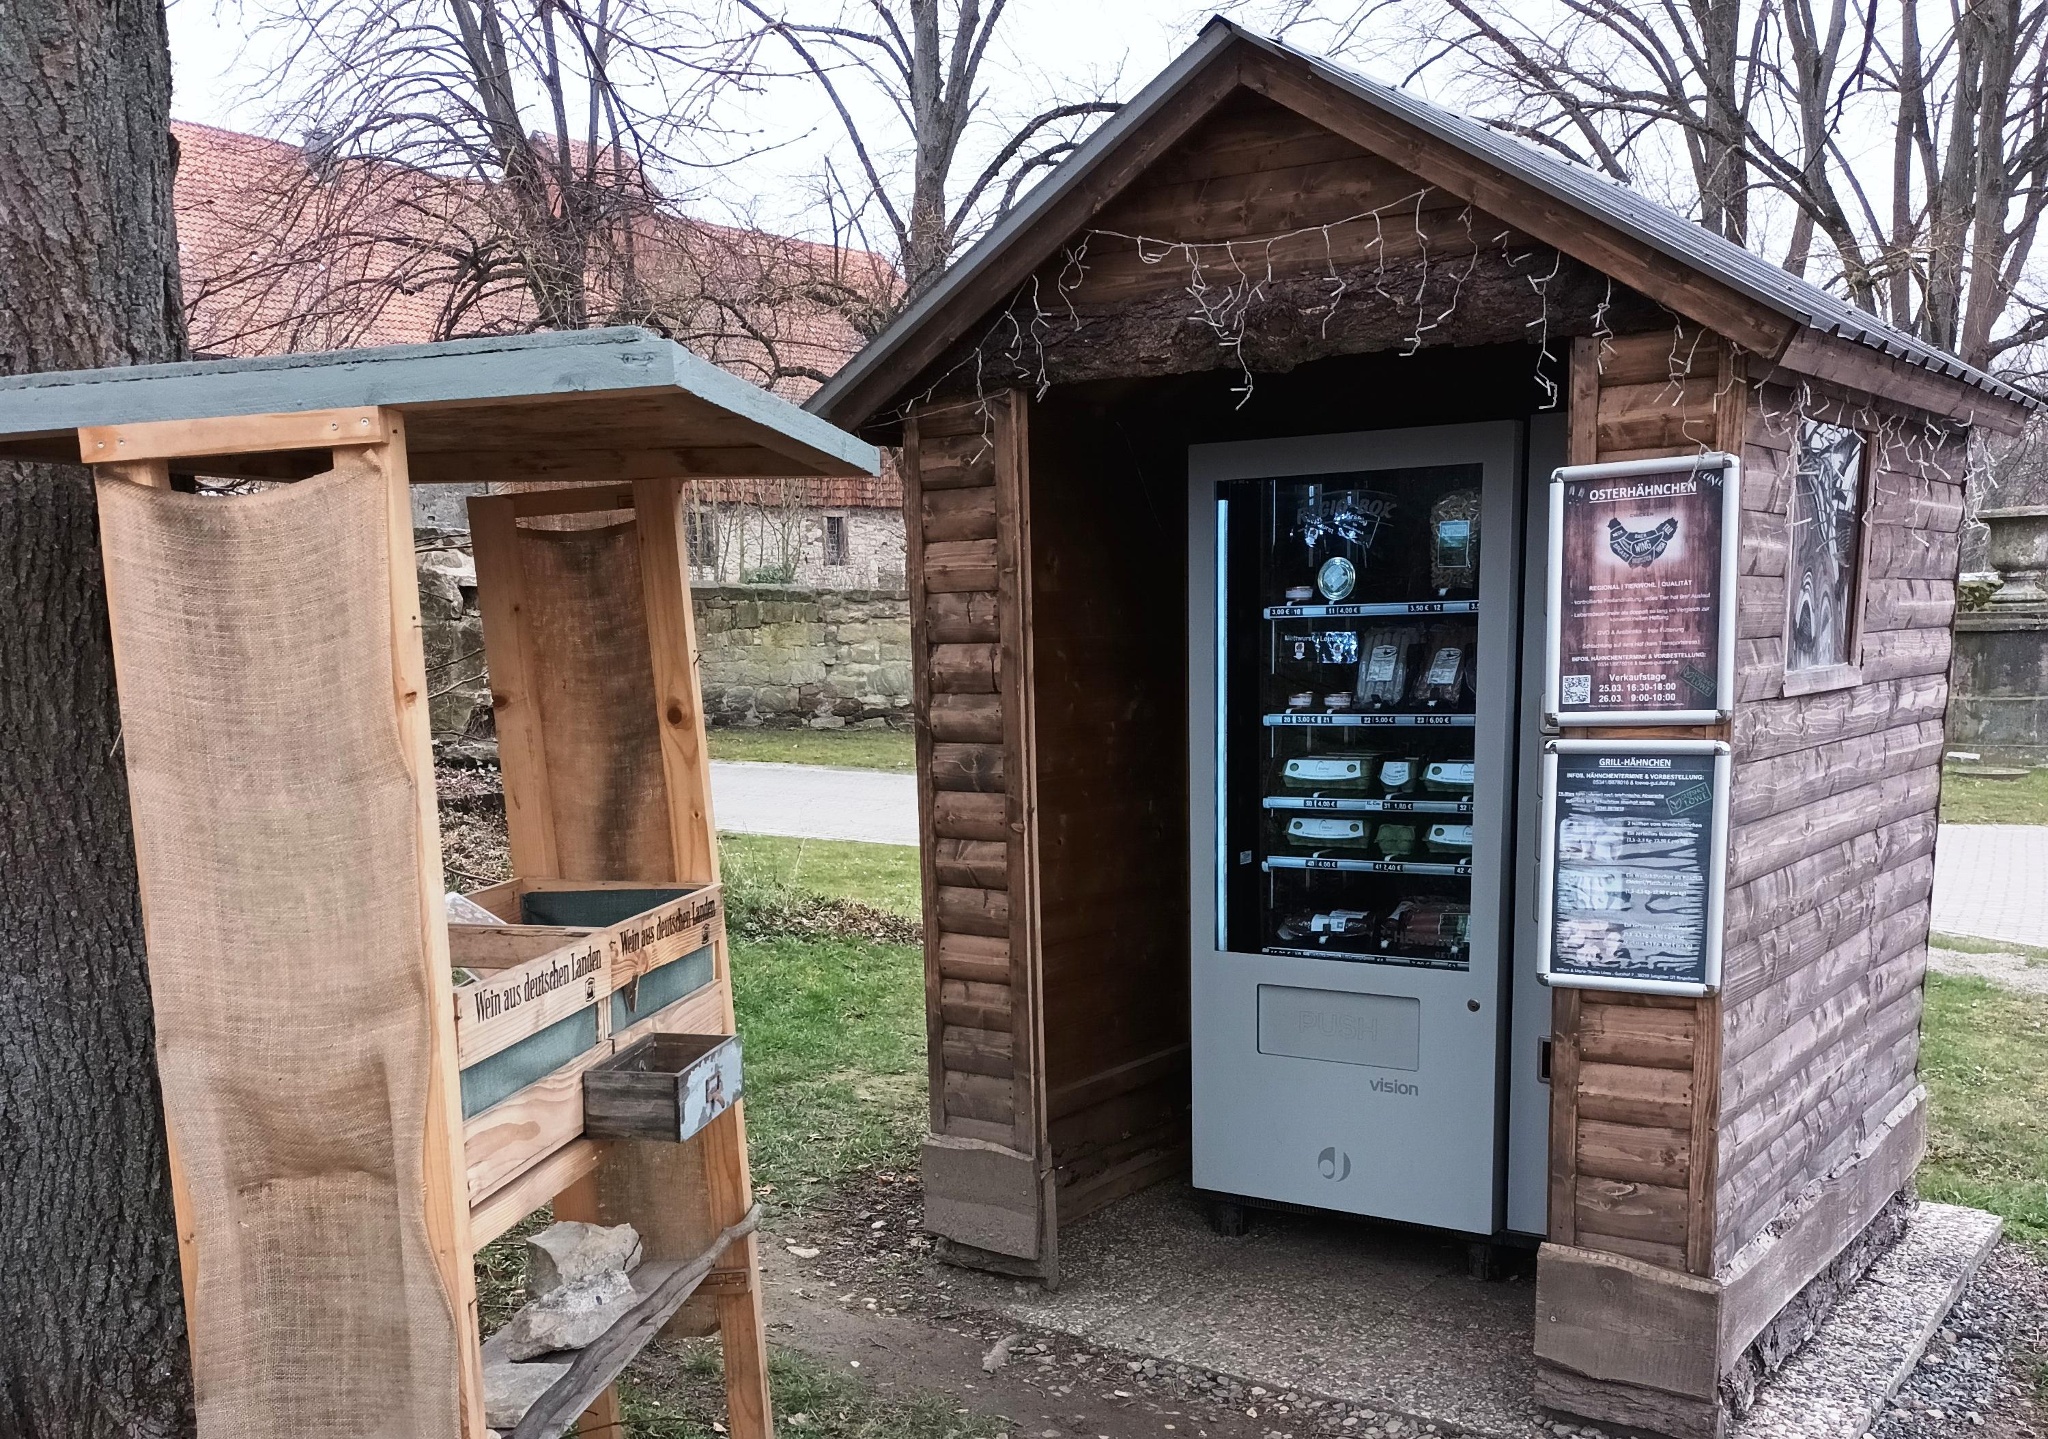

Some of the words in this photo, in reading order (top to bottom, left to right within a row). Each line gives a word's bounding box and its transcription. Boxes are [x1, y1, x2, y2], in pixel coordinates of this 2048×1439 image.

[1589, 481, 1697, 501] OSTERHÄHNCHEN
[1634, 539, 1652, 553] WING
[1661, 579, 1692, 588] QUALITÄT
[1609, 673, 1667, 682] Verkaufstage
[1598, 684, 1624, 692] 25.03.
[1630, 693, 1676, 702] 9:00-10:00
[1599, 757, 1671, 767] GRILL-HÄHNCHEN
[1586, 771, 1644, 780] HÄHNCHENTERMINE
[1650, 773, 1705, 781] VORBESTELLUNG:
[619, 926, 640, 957] Wein
[641, 926, 655, 949] aus
[657, 908, 691, 941] deutschen
[692, 897, 717, 926] Landen
[474, 987, 502, 1023] Wein
[503, 986, 522, 1010] aus
[524, 959, 570, 1002] deutschen
[571, 946, 602, 983] Landen
[1298, 1010, 1378, 1042] PUSH
[1369, 1077, 1419, 1097] vision
